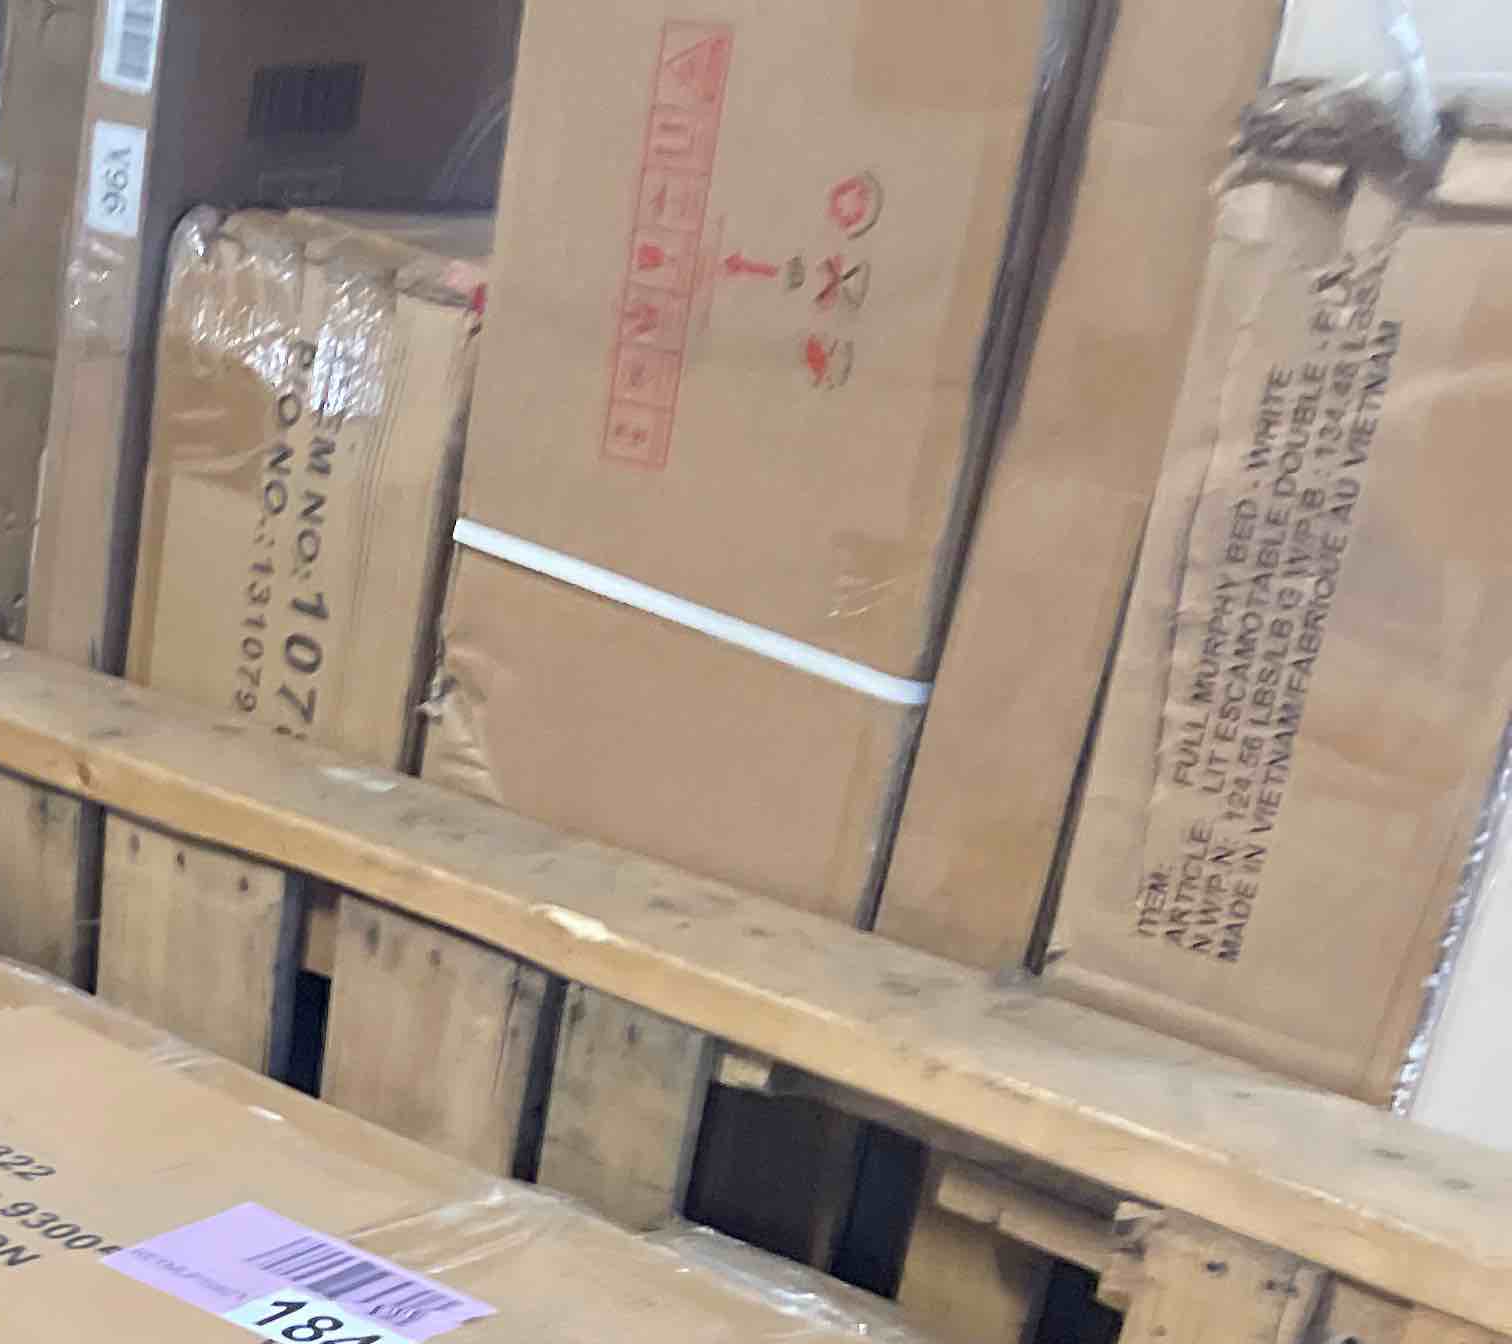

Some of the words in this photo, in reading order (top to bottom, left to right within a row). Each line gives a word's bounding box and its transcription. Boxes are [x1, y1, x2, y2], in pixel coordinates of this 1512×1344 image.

[1245, 365, 1294, 471] WHITE
[1273, 361, 1328, 499] DOUBLE
[1340, 320, 1402, 467] VIETNAM
[1226, 499, 1259, 564] BED
[1330, 478, 1362, 526] AU
[272, 591, 331, 739] 107
[1191, 573, 1241, 704] MURPHY
[1214, 508, 1290, 743] ESCAMOTABLE
[1173, 711, 1210, 788] FULL
[1201, 748, 1230, 795] LIT
[1241, 844, 1268, 875] IN
[1217, 880, 1258, 962] MADE
